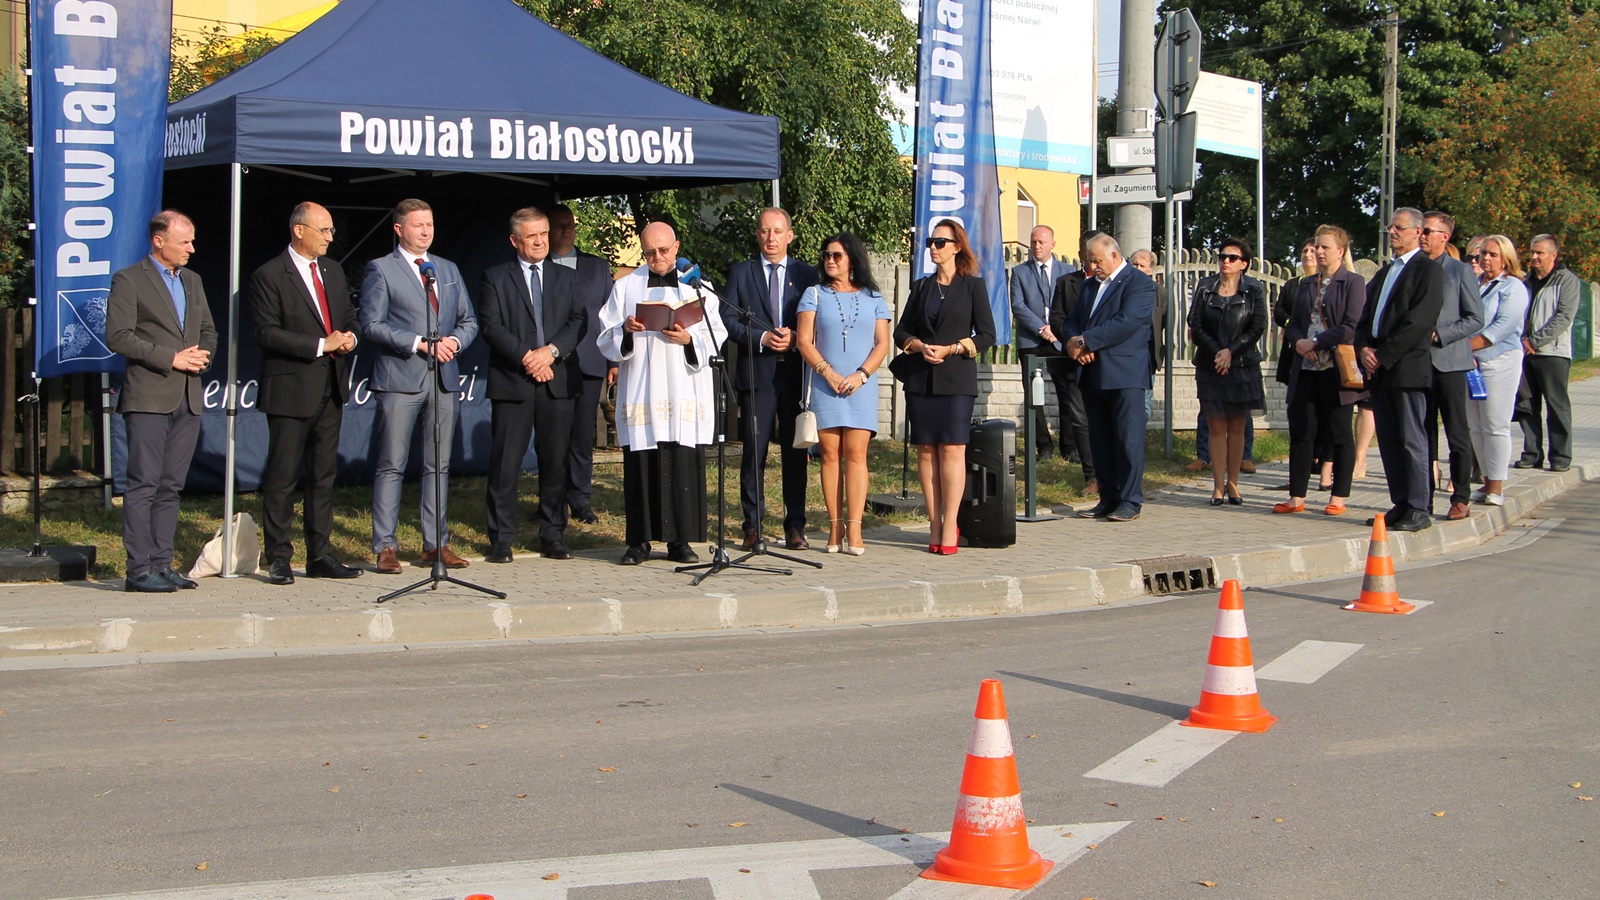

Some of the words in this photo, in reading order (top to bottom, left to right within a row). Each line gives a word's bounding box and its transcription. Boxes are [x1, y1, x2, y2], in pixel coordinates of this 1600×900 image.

[1016, 0, 1058, 14] publicznej
[1017, 15, 1041, 26] Narwi
[1001, 70, 1015, 80] 978
[1017, 72, 1033, 82] PLN
[992, 91, 1027, 103] uropejską
[340, 111, 474, 159] Powiat
[489, 118, 695, 165] Białostocki
[1133, 147, 1141, 155] ul.
[1031, 150, 1077, 165] środowiska
[54, 65, 117, 277] Powiat
[1103, 185, 1112, 193] ul.
